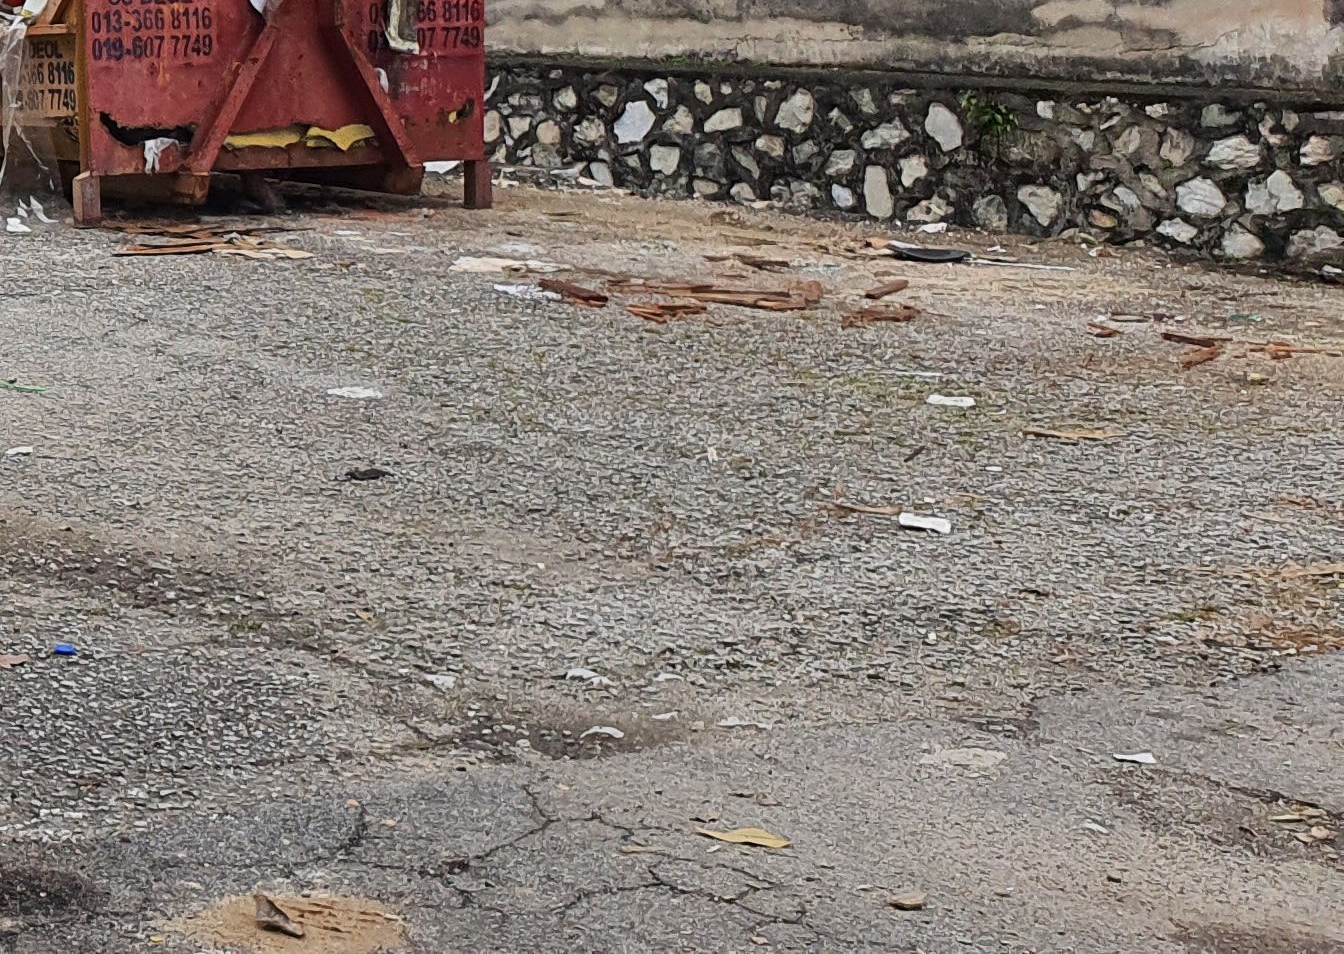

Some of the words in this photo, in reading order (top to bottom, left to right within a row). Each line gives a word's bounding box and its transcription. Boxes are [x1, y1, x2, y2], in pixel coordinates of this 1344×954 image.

[92, 8, 165, 33] 013-366
[170, 7, 212, 30] 8116
[92, 35, 165, 61] 019-607
[170, 34, 212, 58] 7749
[48, 88, 76, 111] 7749
